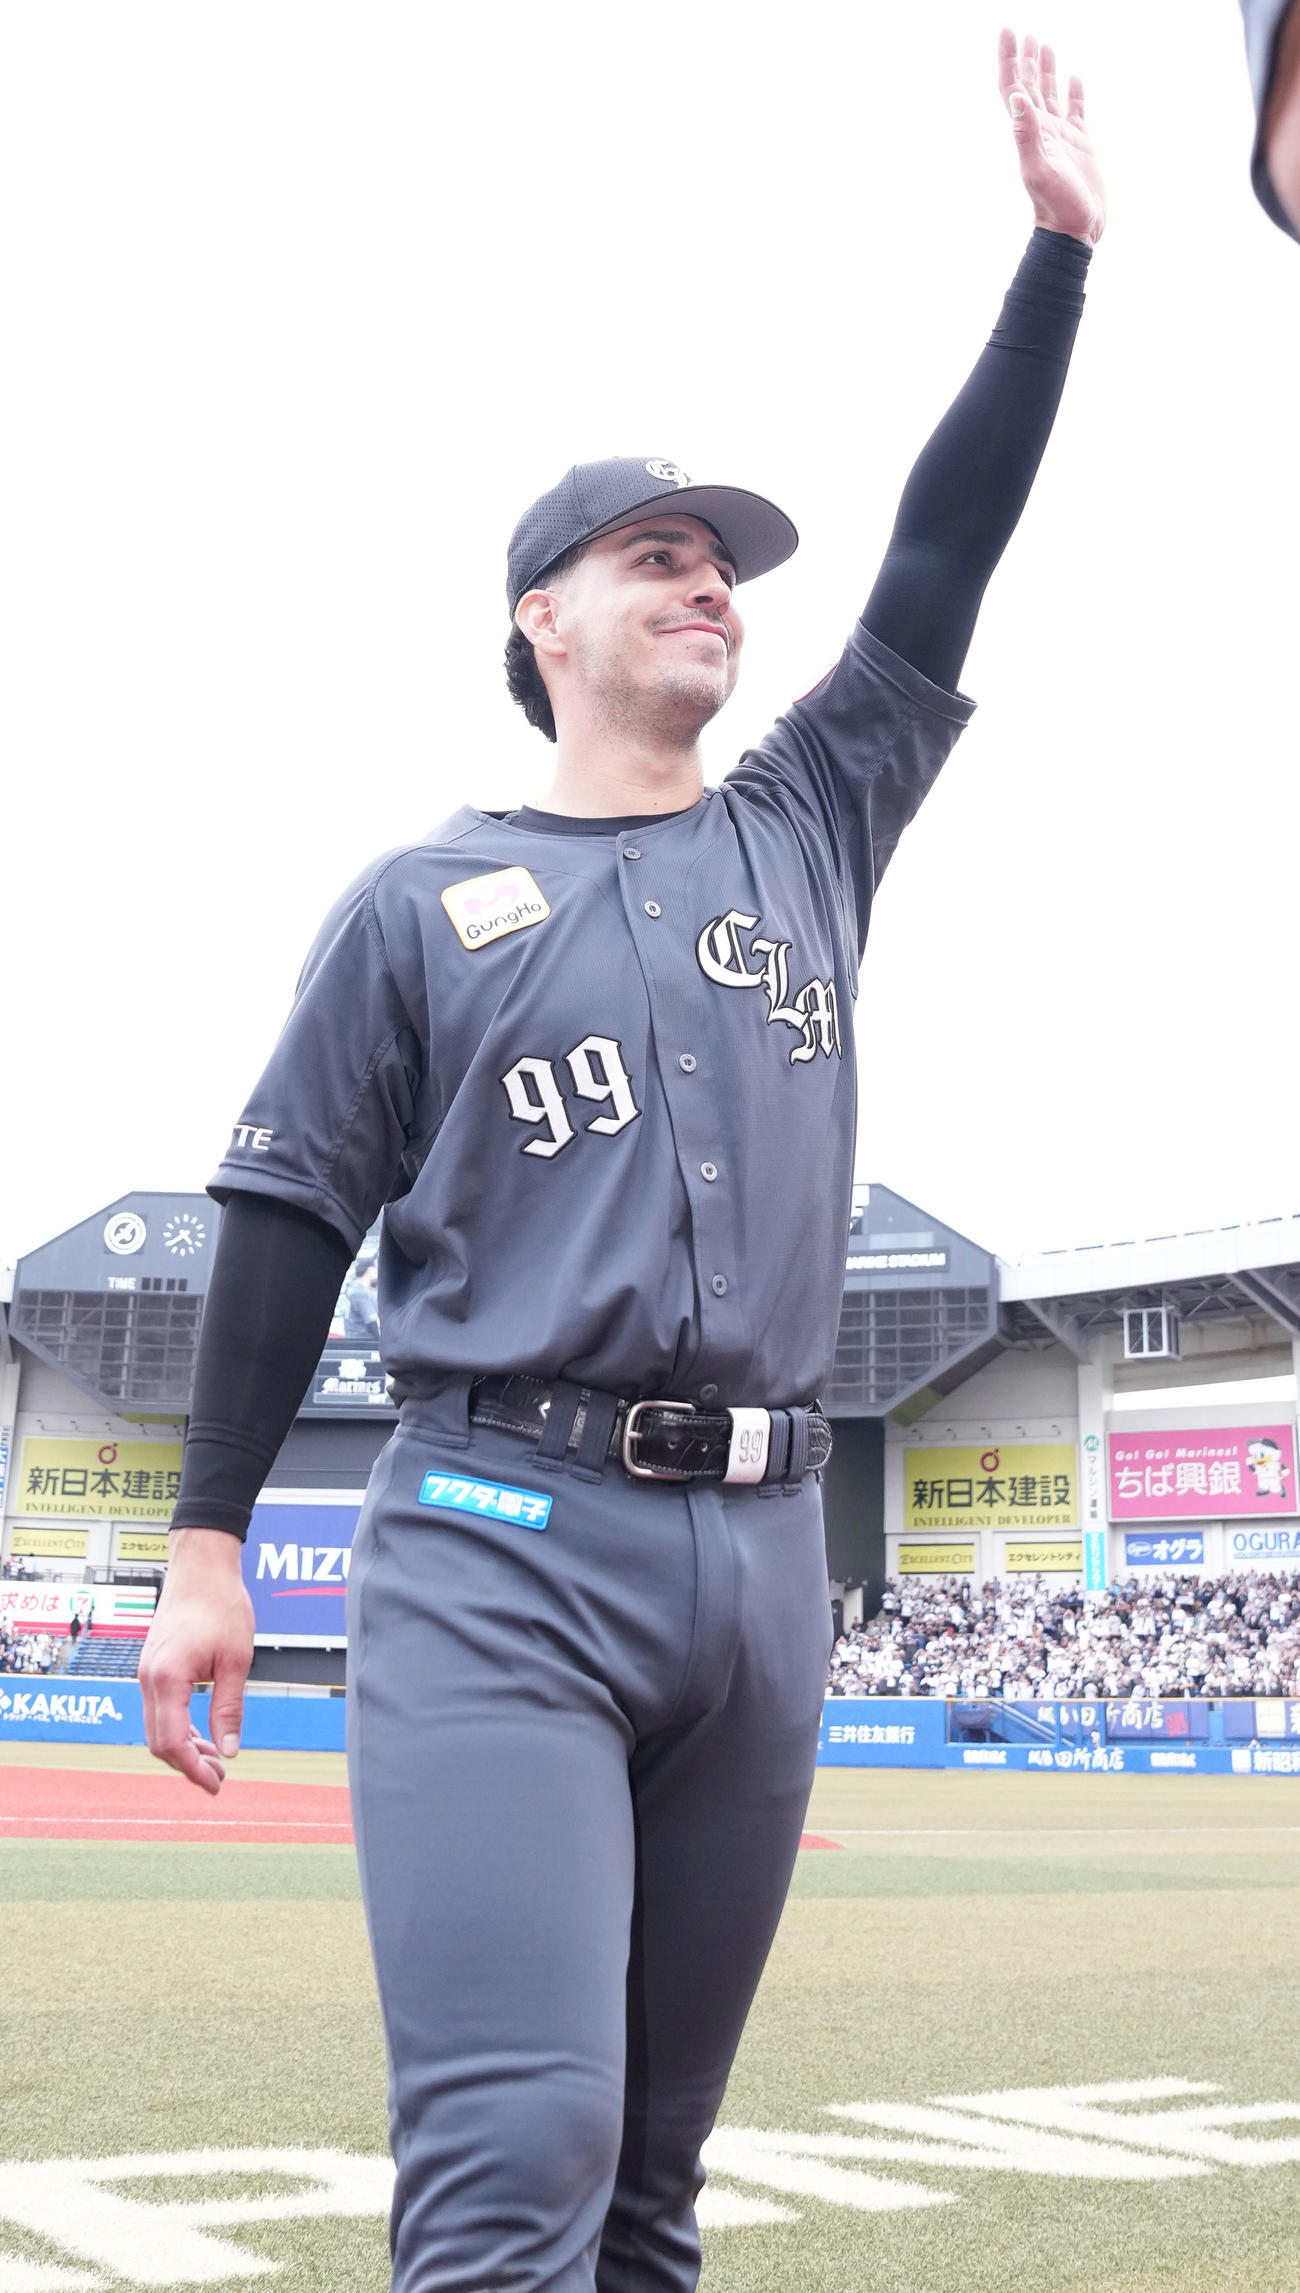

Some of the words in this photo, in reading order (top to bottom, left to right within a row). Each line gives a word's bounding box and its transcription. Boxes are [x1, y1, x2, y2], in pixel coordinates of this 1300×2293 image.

[466, 903, 541, 939] GungHo
[500, 1033, 642, 1159] 99
[888, 1253, 946, 1268] STADIUM
[108, 1277, 136, 1290] TIME
[739, 1429, 763, 1464] 99
[26, 1466, 182, 1501] 新日本建設
[912, 1475, 1071, 1509] 新日本建設
[1115, 1461, 1242, 1498] ちば興銀
[26, 1502, 102, 1514] INTELLIGENT
[913, 1515, 991, 1527] INTELLIGENT
[998, 1514, 1071, 1525] DEVELOPER
[1152, 1538, 1203, 1561] オグラ
[13, 1693, 116, 1718] KAKUTA
[828, 1725, 915, 1744] 三井住友銀行
